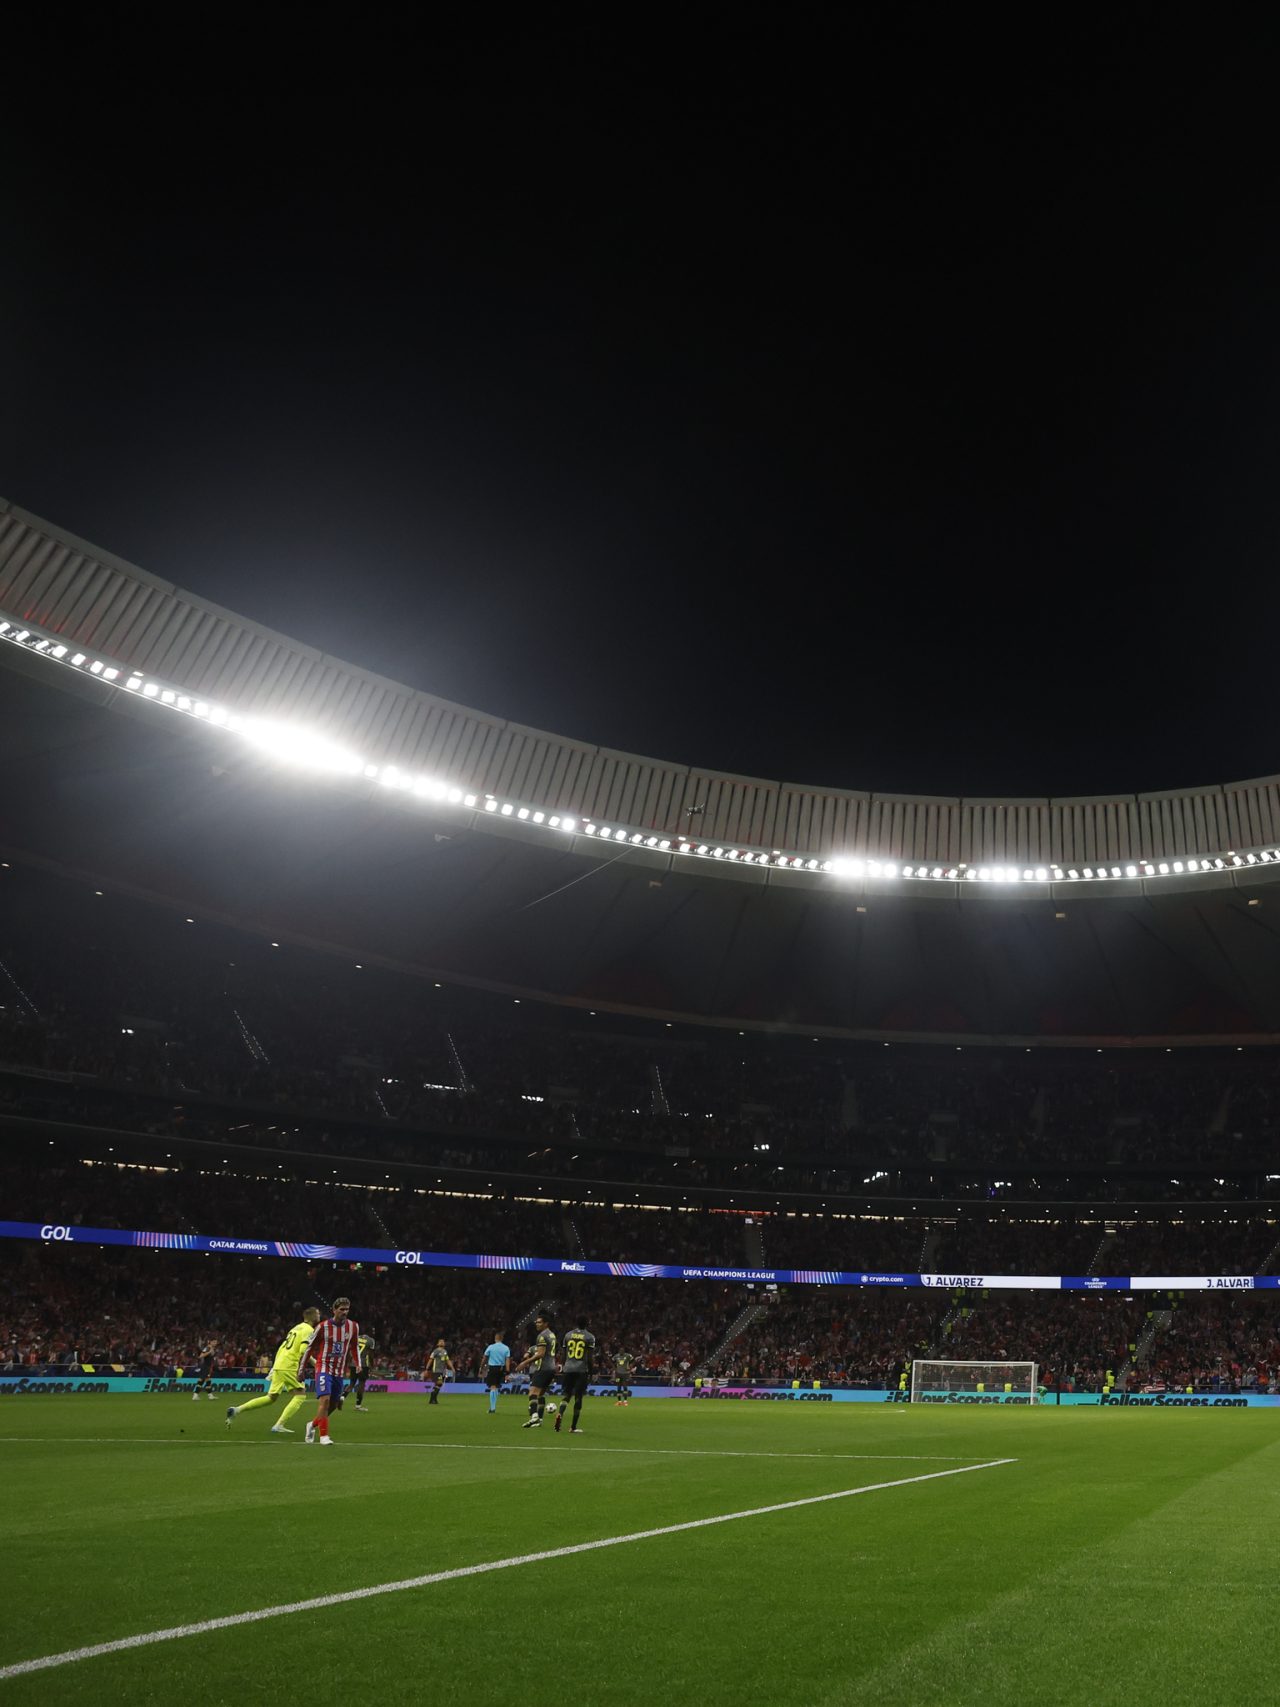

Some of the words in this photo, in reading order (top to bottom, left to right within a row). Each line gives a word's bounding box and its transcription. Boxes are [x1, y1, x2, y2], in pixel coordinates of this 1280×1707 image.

[40, 1225, 74, 1241] GOL
[209, 1240, 235, 1250] QATAR
[236, 1242, 268, 1252] AIRWAYS
[395, 1251, 424, 1265] GOL
[561, 1262, 585, 1272] FedEx
[683, 1269, 702, 1277] UEFA
[703, 1270, 747, 1279] CHAMPIONS
[747, 1271, 776, 1280] LEAGUE
[869, 1276, 904, 1284] crypto.com
[926, 1277, 934, 1286] J.
[935, 1277, 984, 1287] ALVAREZ
[1207, 1278, 1215, 1288] J.
[567, 1339, 586, 1360] 36
[319, 1375, 326, 1386] 5
[691, 1387, 832, 1402] FollowScores.com
[1100, 1394, 1248, 1407] FollowScores.com
